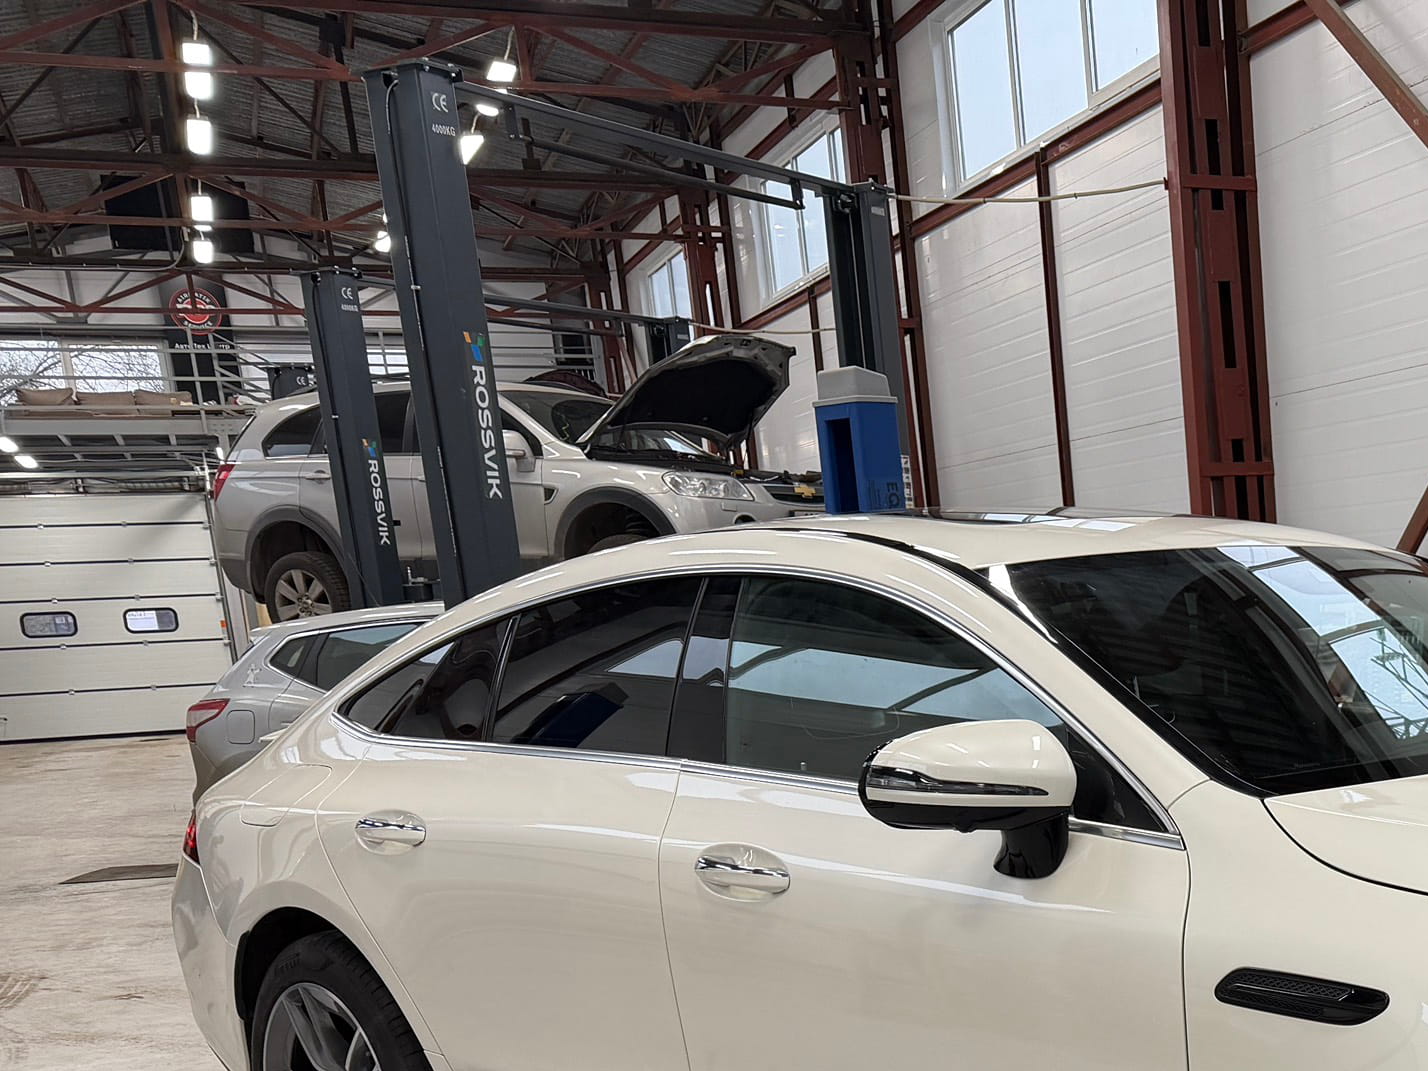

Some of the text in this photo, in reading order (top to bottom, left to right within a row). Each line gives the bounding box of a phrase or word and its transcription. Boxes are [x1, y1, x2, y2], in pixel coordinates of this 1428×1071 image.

[432, 92, 449, 113] CE
[471, 365, 503, 500] ROSSVIK
[367, 459, 391, 545] ROSSVIK
